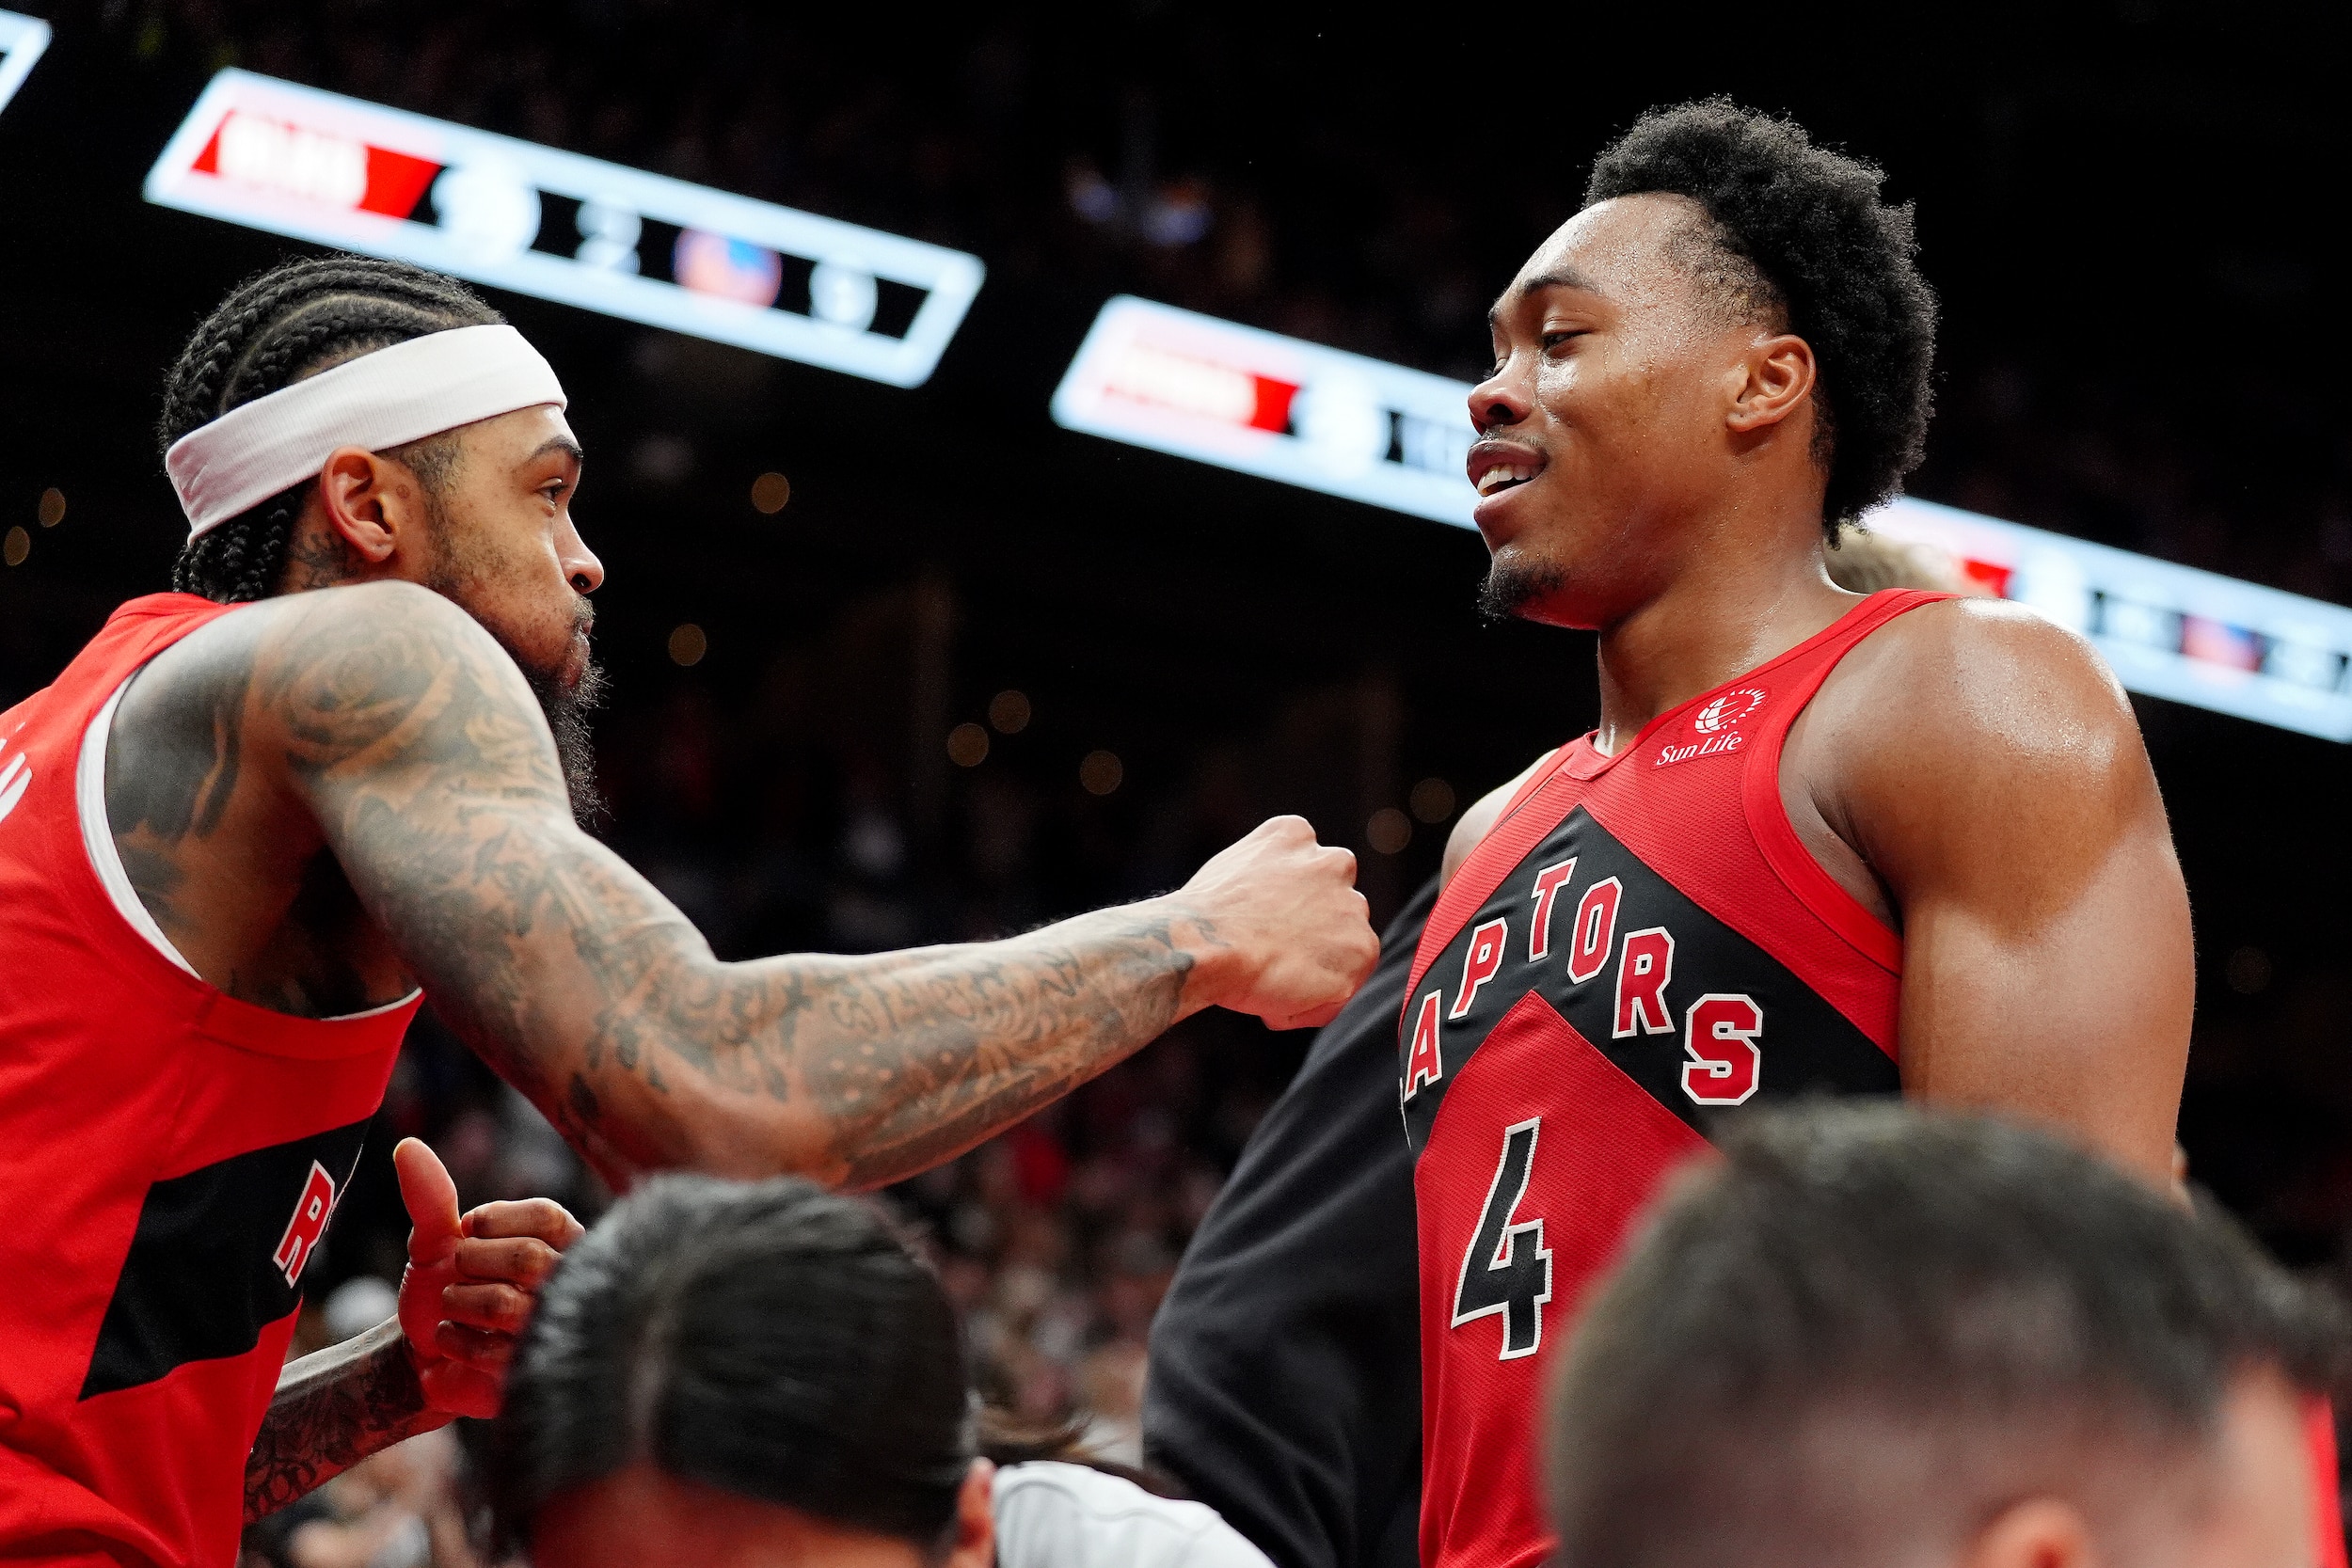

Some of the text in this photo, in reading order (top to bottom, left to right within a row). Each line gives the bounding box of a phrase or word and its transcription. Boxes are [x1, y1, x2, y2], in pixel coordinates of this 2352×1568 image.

[1656, 730, 1742, 766] Sun Life
[1400, 856, 1763, 1107] APTORS
[1450, 1116, 1553, 1361] 4
